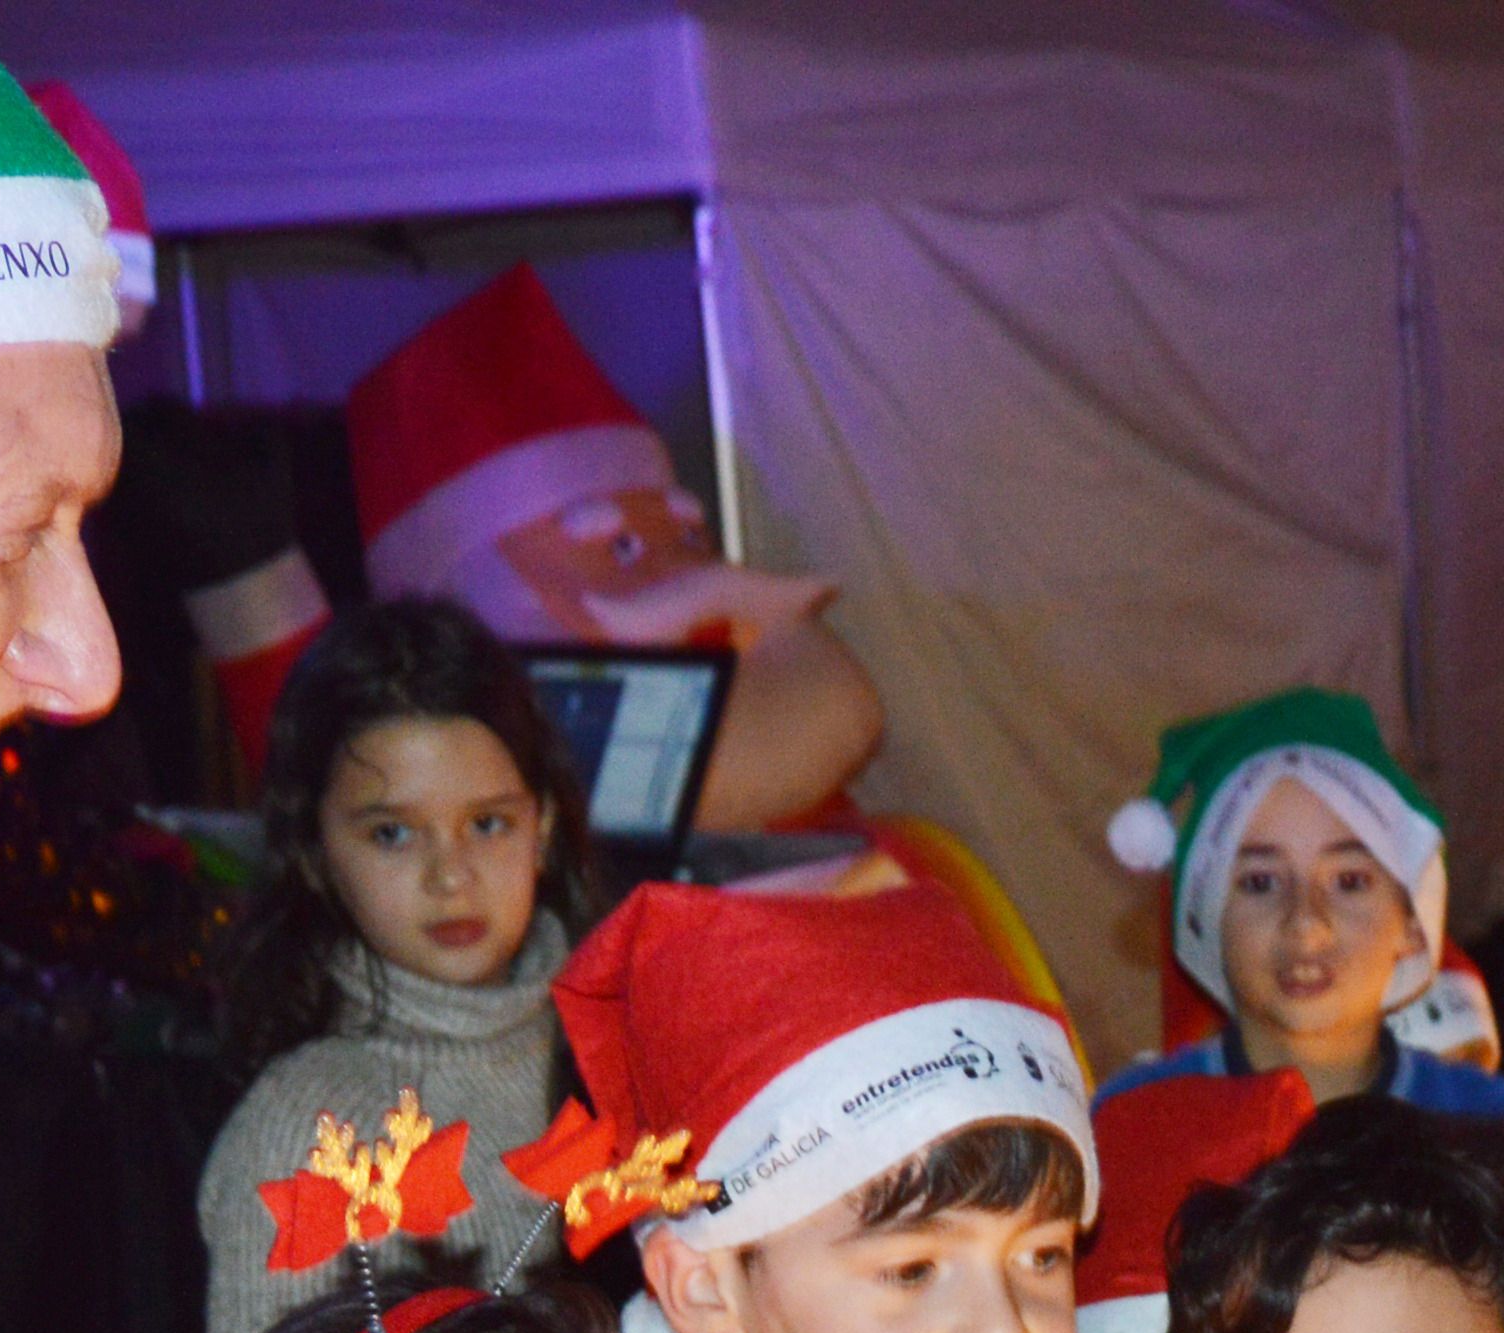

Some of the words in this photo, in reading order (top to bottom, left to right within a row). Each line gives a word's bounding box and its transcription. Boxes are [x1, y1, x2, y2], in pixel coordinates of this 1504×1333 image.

[841, 1052, 981, 1116] entretendas
[731, 1170, 754, 1195] DE
[756, 1126, 833, 1180] GALICIA
